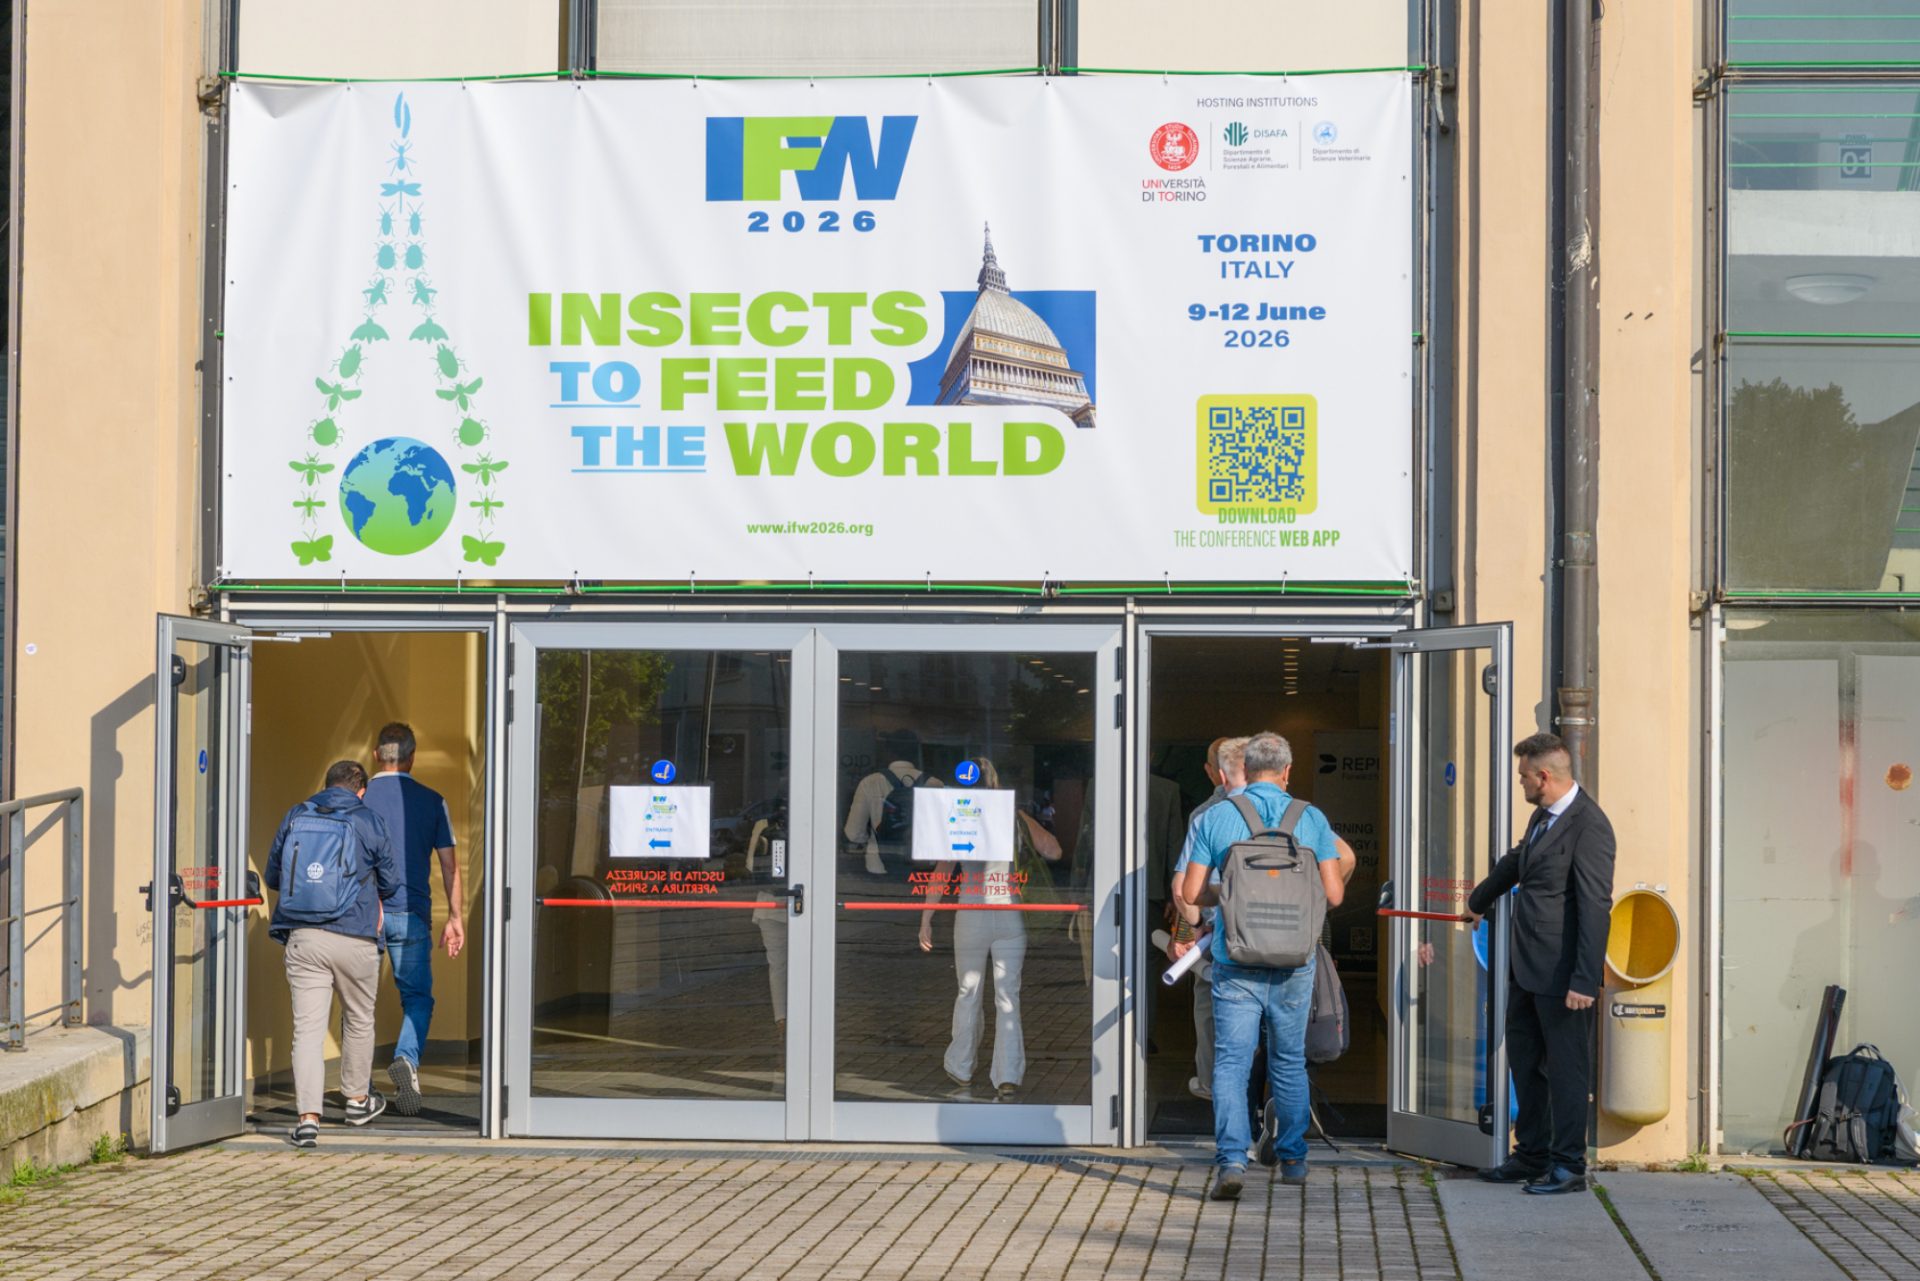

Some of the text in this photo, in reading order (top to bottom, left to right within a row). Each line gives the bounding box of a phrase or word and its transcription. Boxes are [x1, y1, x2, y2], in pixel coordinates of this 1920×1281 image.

[1197, 97, 1318, 108] HOSTING INSTITUTIONS
[1253, 129, 1288, 138] DISAFA
[705, 115, 918, 202] IFW
[1142, 176, 1206, 189] UNIVERSITÀ
[1142, 191, 1206, 202] DI TORINO
[747, 210, 876, 233] 2026
[1197, 233, 1317, 253] TORINO
[1221, 260, 1295, 279] ITALY
[528, 290, 929, 347] INSECTS
[1188, 302, 1327, 321] 9-12 June
[1224, 329, 1291, 348] 2026
[549, 356, 896, 412] TO FEED
[571, 420, 1066, 478] THE WORLD
[1218, 507, 1297, 524] DOWNLOAD
[747, 521, 874, 537] www.ifw2026.org
[1174, 530, 1341, 548] THE CONFERENCE WEB APP
